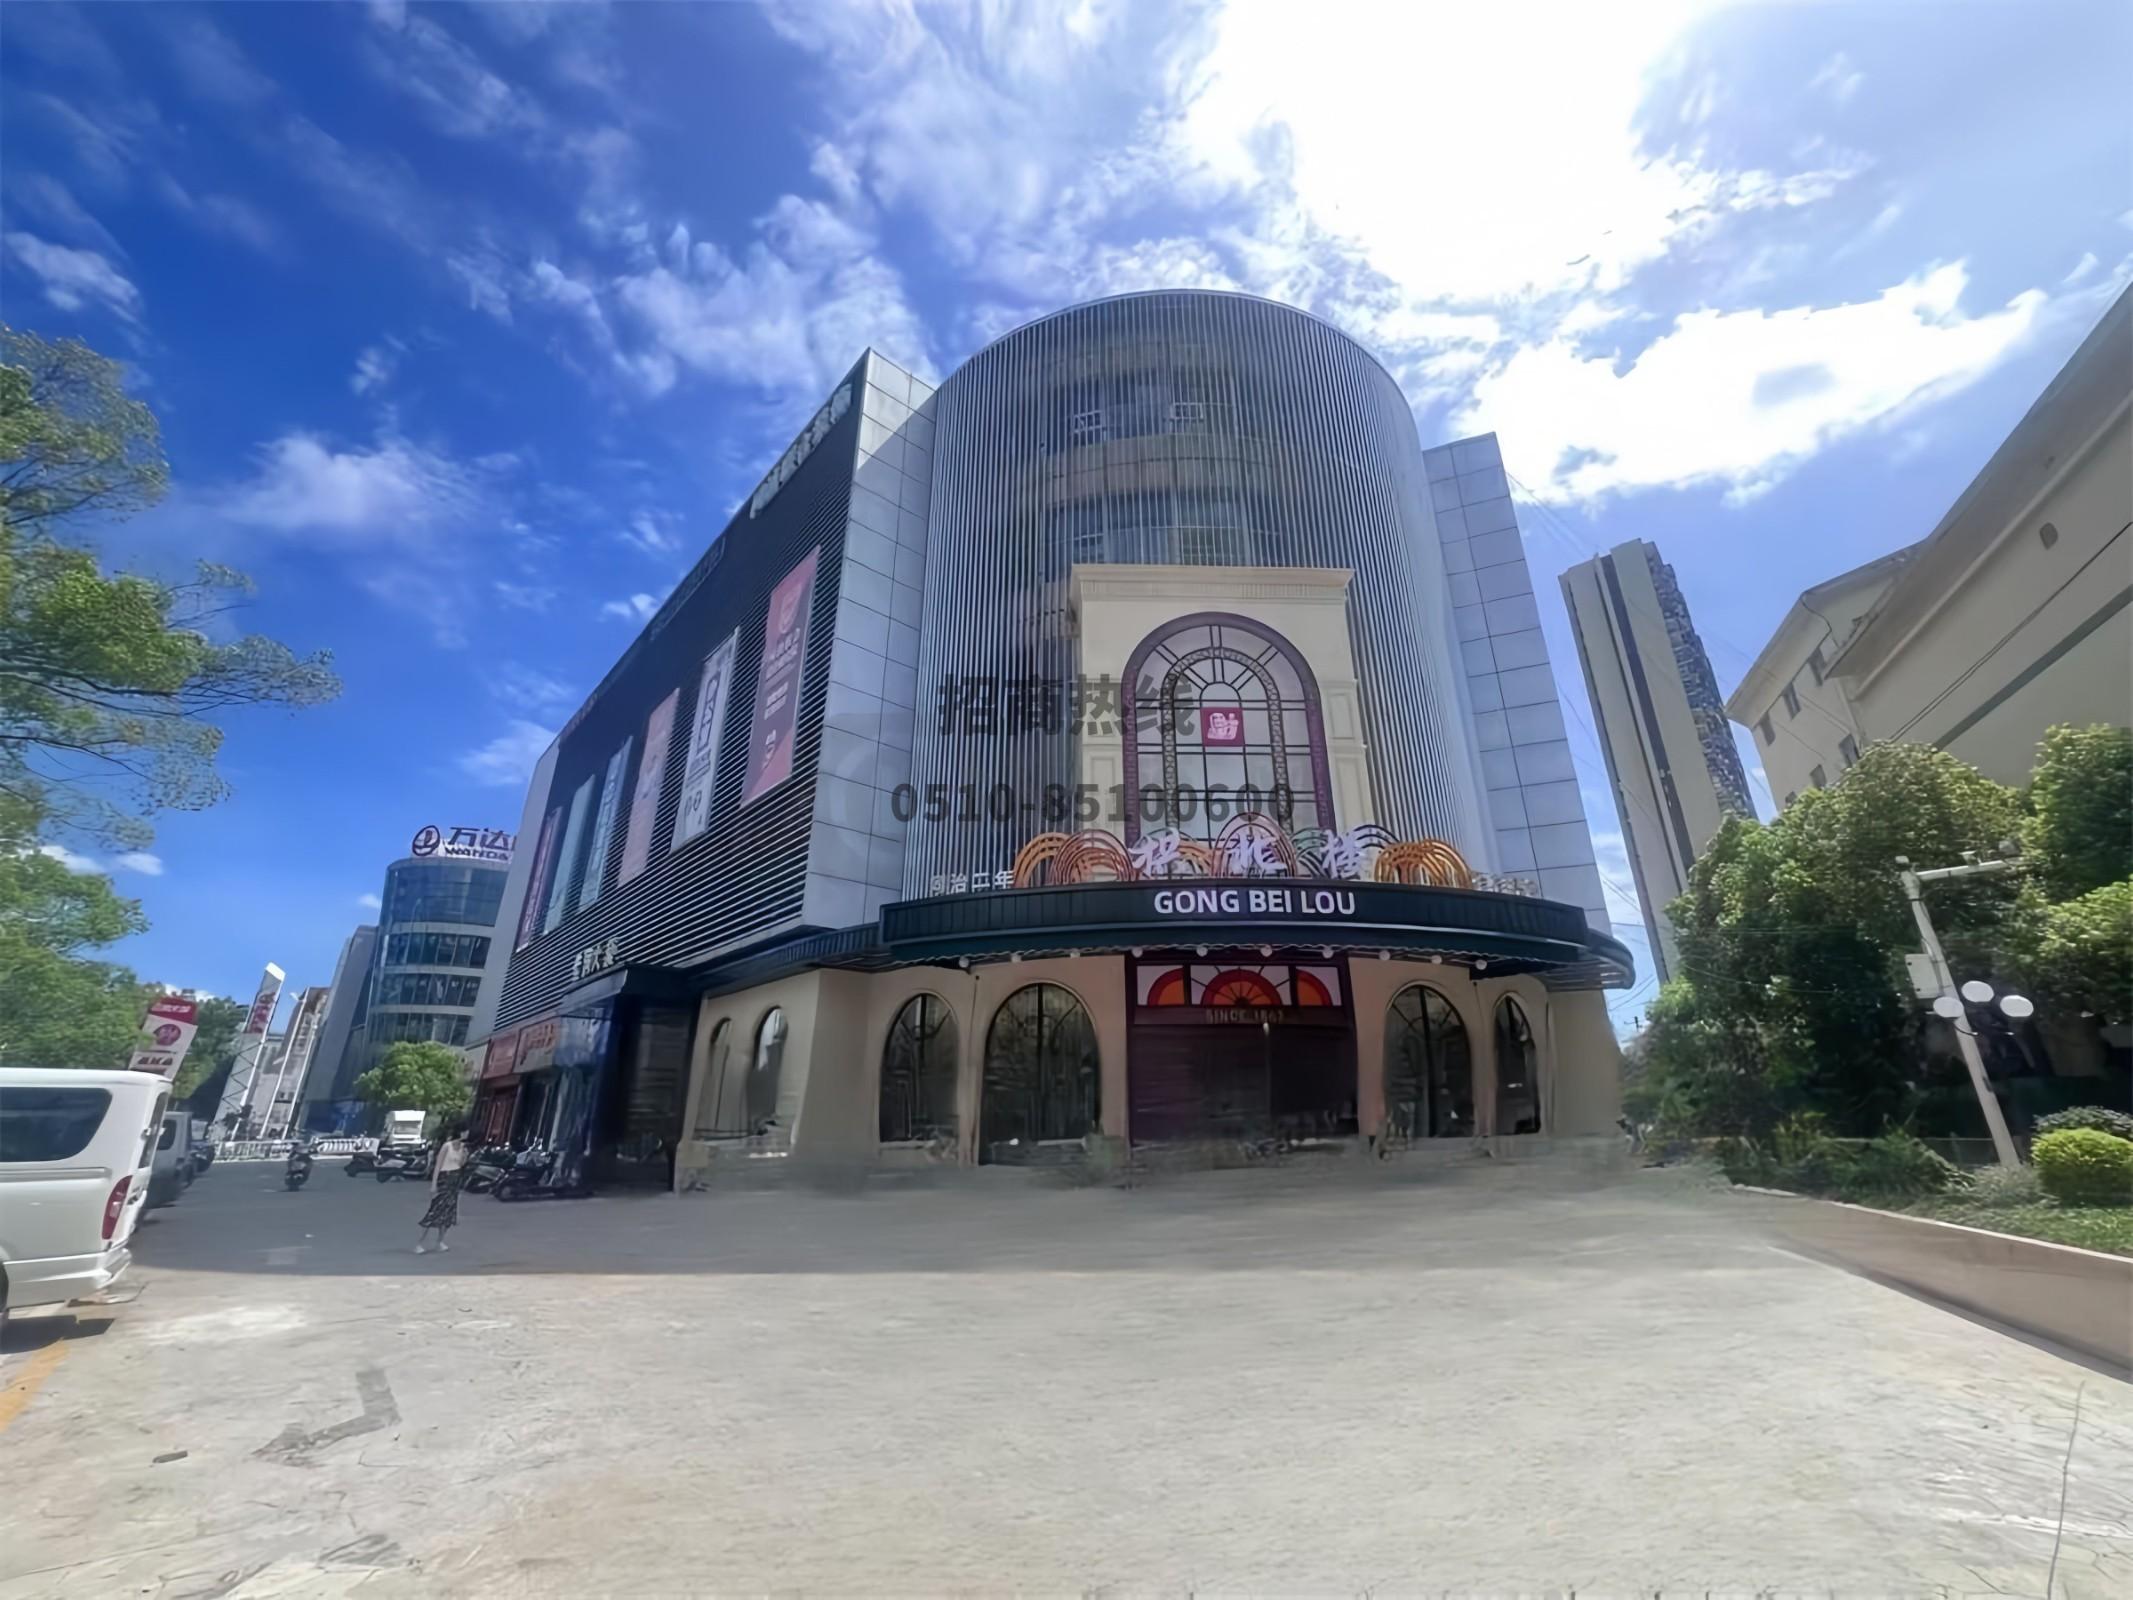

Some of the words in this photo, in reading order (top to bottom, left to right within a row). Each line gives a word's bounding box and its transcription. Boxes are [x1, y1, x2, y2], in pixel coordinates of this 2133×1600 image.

[450, 827, 516, 850] 万达
[1154, 890, 1239, 915] GONG
[1250, 890, 1292, 914] BEI
[1301, 891, 1356, 915] LOU
